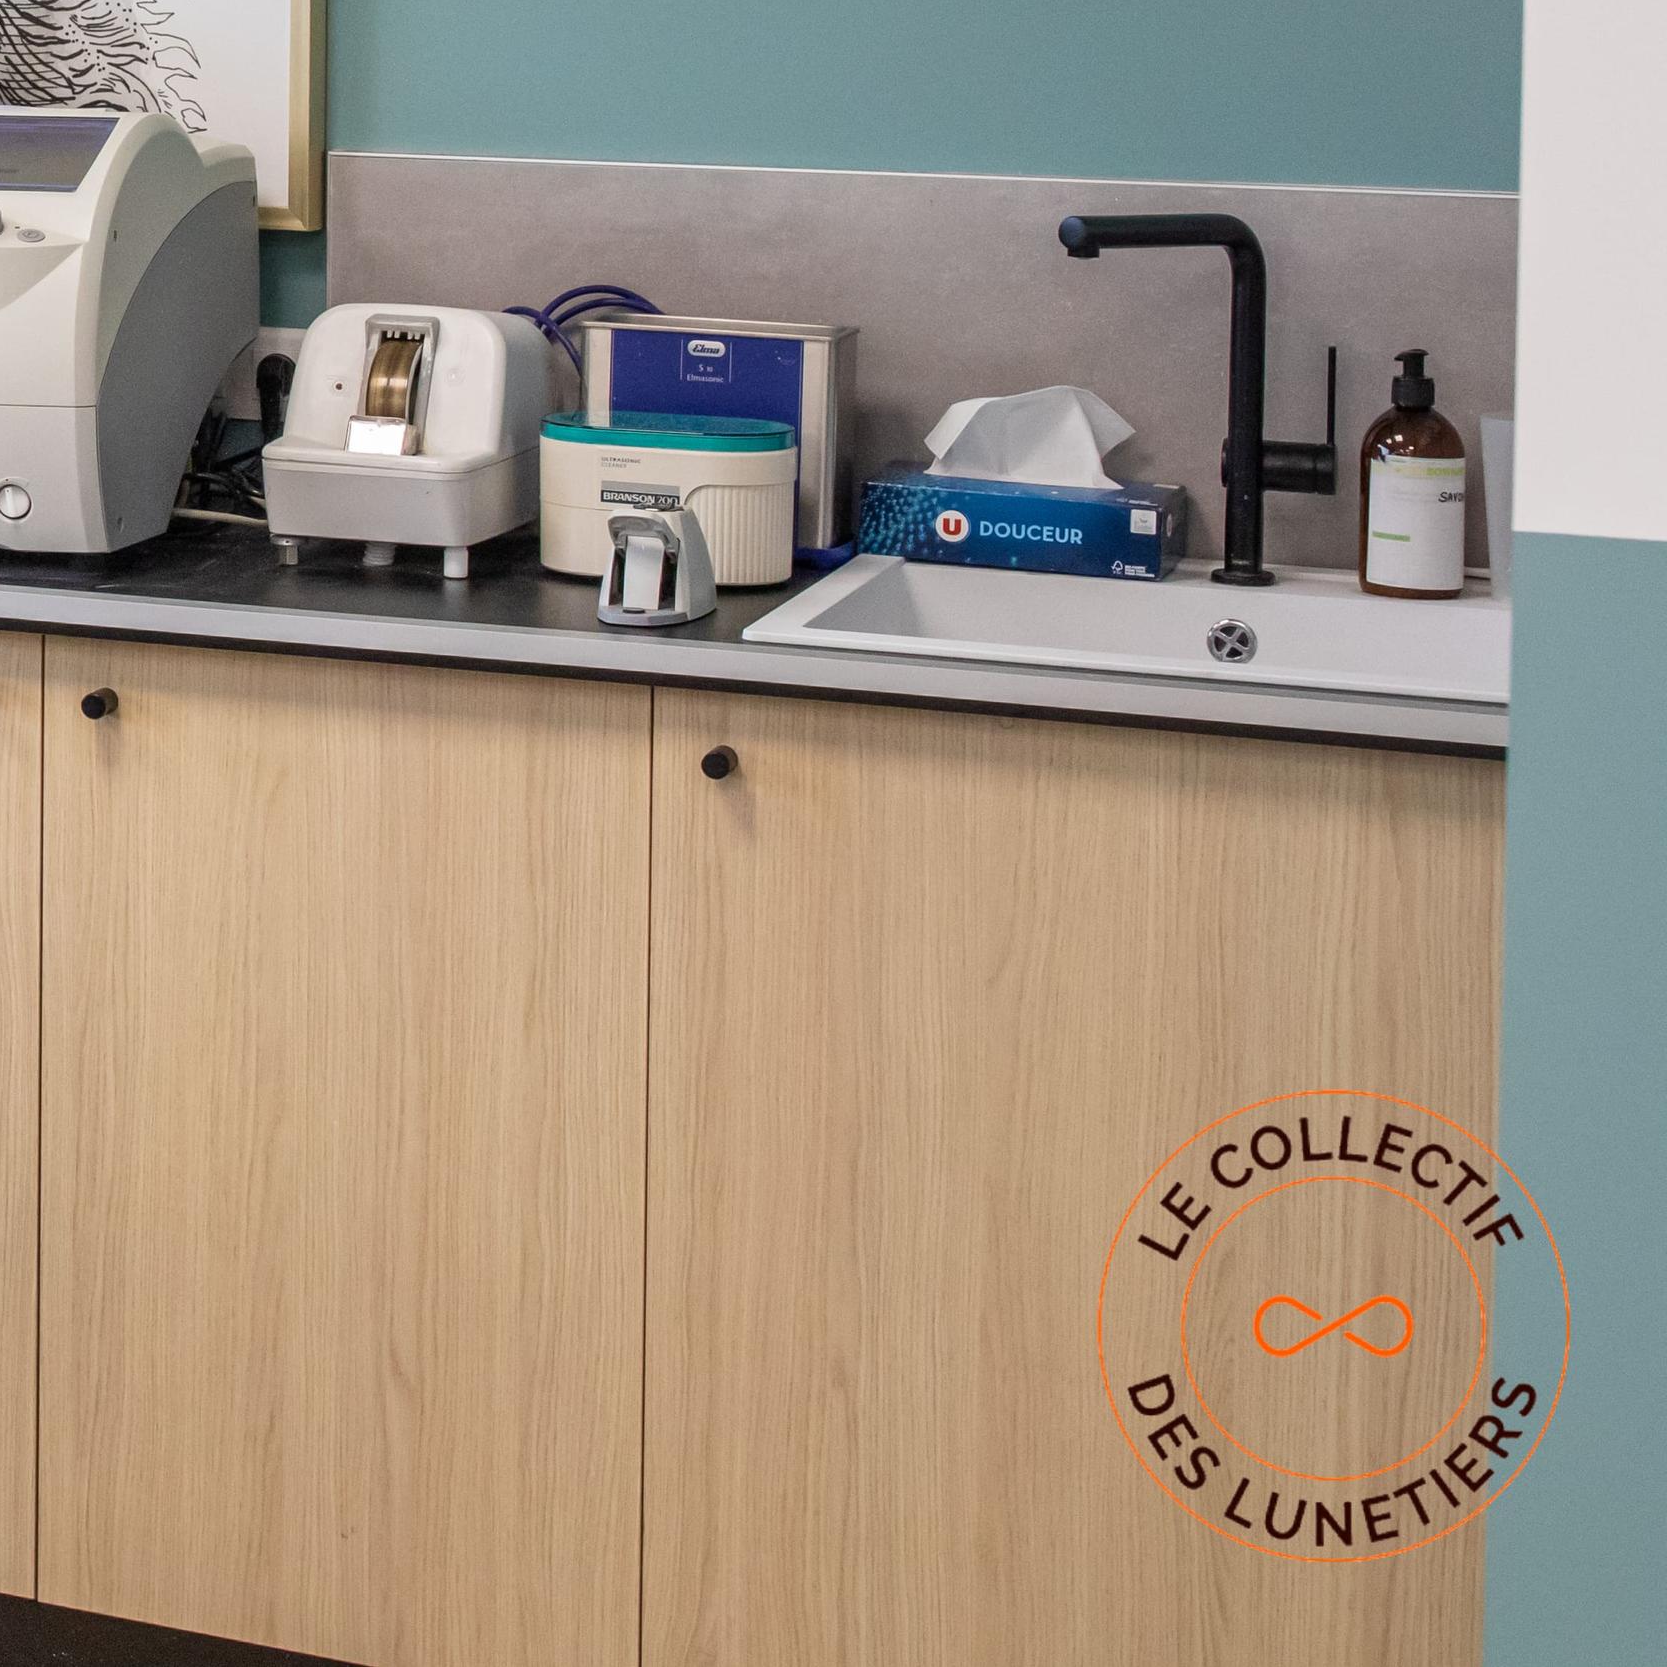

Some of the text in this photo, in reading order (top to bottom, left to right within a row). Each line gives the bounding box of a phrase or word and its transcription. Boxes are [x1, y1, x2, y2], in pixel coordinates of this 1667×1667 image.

[692, 344, 720, 354] Elma
[687, 374, 724, 383] Elmasonic
[603, 492, 655, 506] BRANSON
[942, 518, 1083, 545] U DOUCEUR
